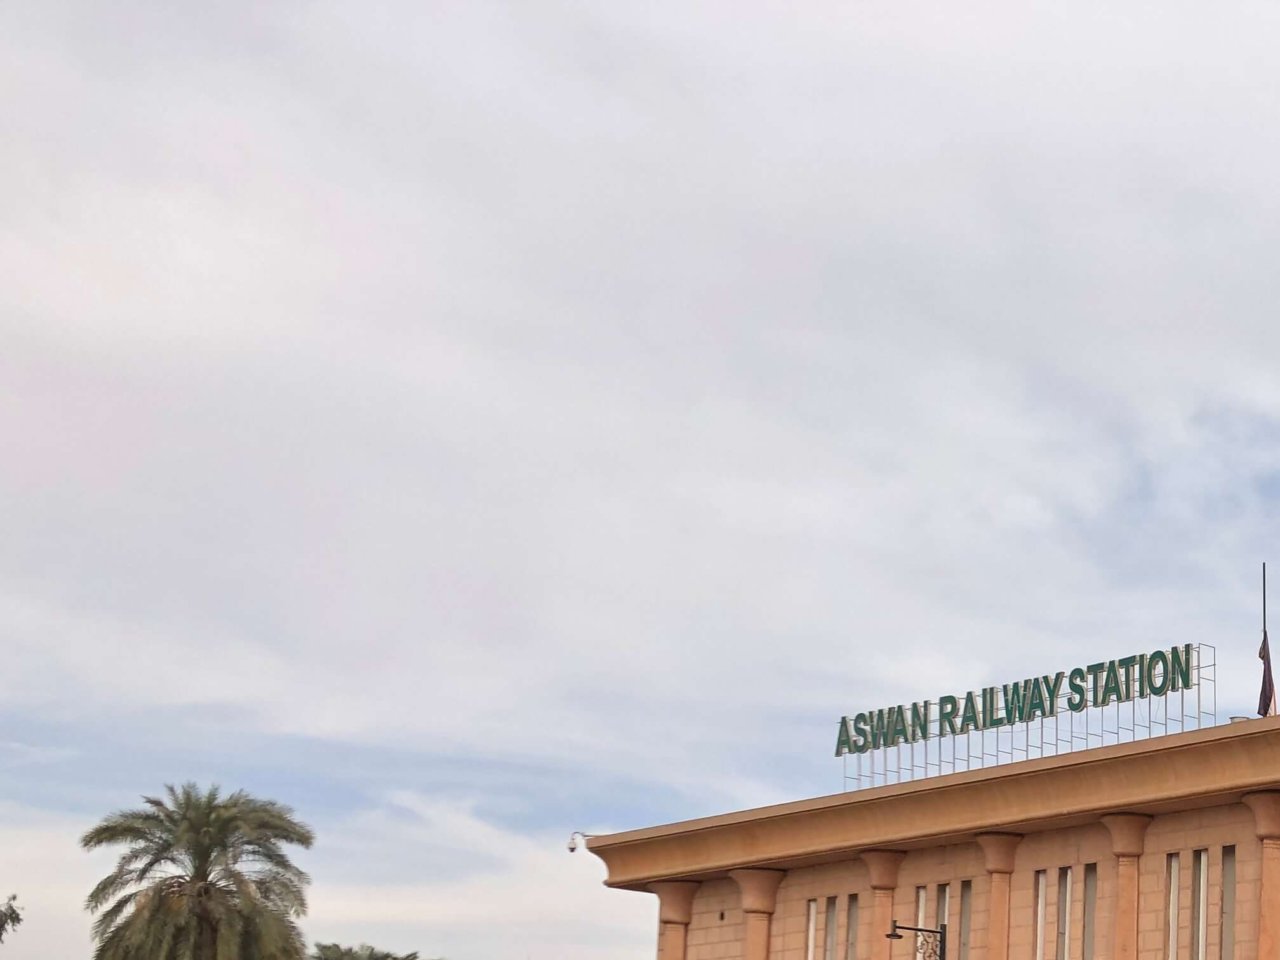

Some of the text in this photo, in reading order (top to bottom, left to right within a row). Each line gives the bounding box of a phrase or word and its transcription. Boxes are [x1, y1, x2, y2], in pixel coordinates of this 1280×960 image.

[834, 643, 1193, 757] ASWAN RAILWAY STATION
